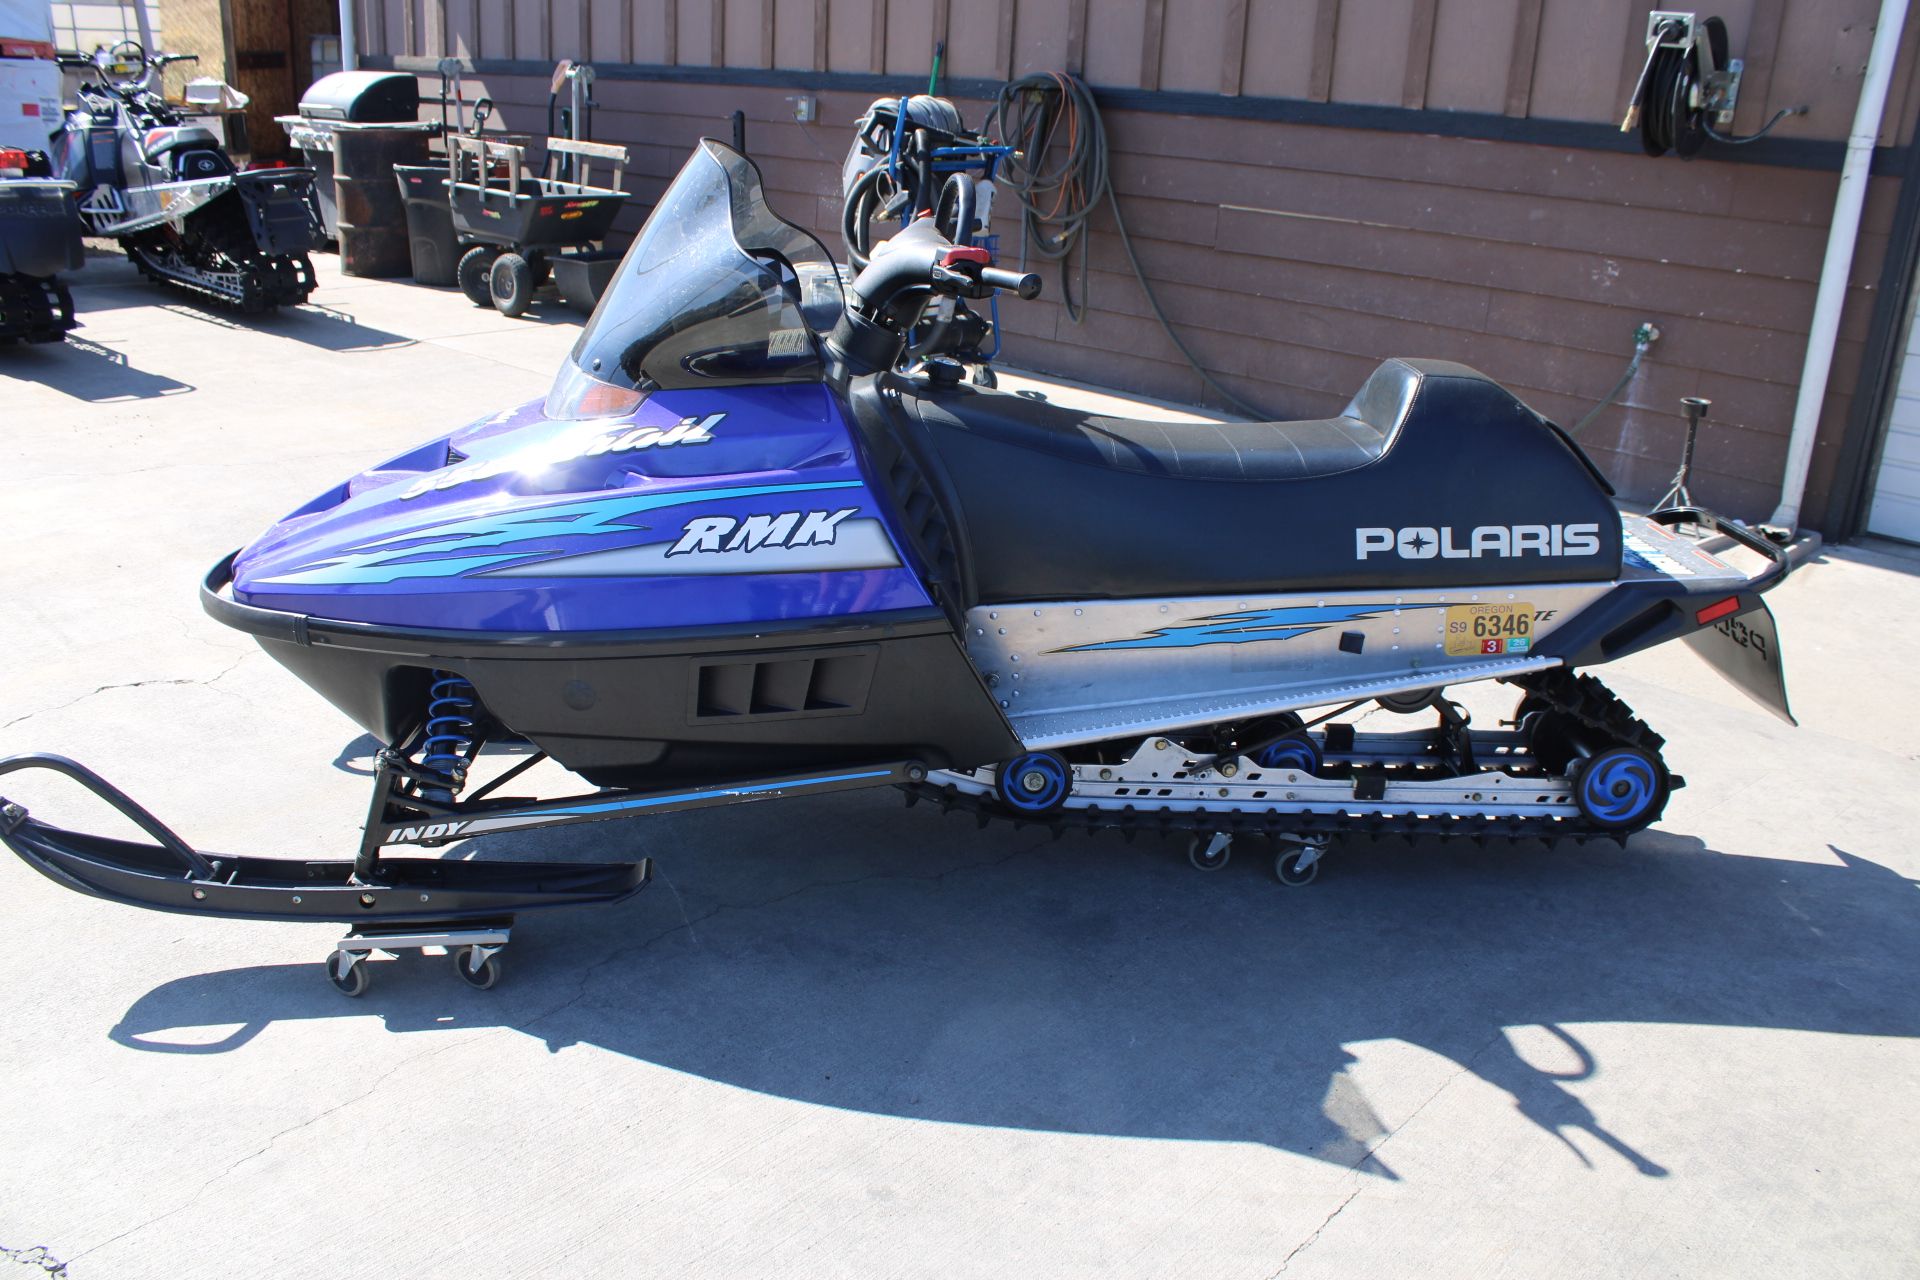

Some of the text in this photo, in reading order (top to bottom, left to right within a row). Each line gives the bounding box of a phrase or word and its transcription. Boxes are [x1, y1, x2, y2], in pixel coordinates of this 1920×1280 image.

[664, 506, 862, 558] RMK
[1356, 523, 1600, 560] POLARIS
[1470, 605, 1513, 615] OREGON
[1449, 613, 1530, 637] S9 6346
[1487, 640, 1497, 653] 3
[385, 820, 469, 843] INDY
